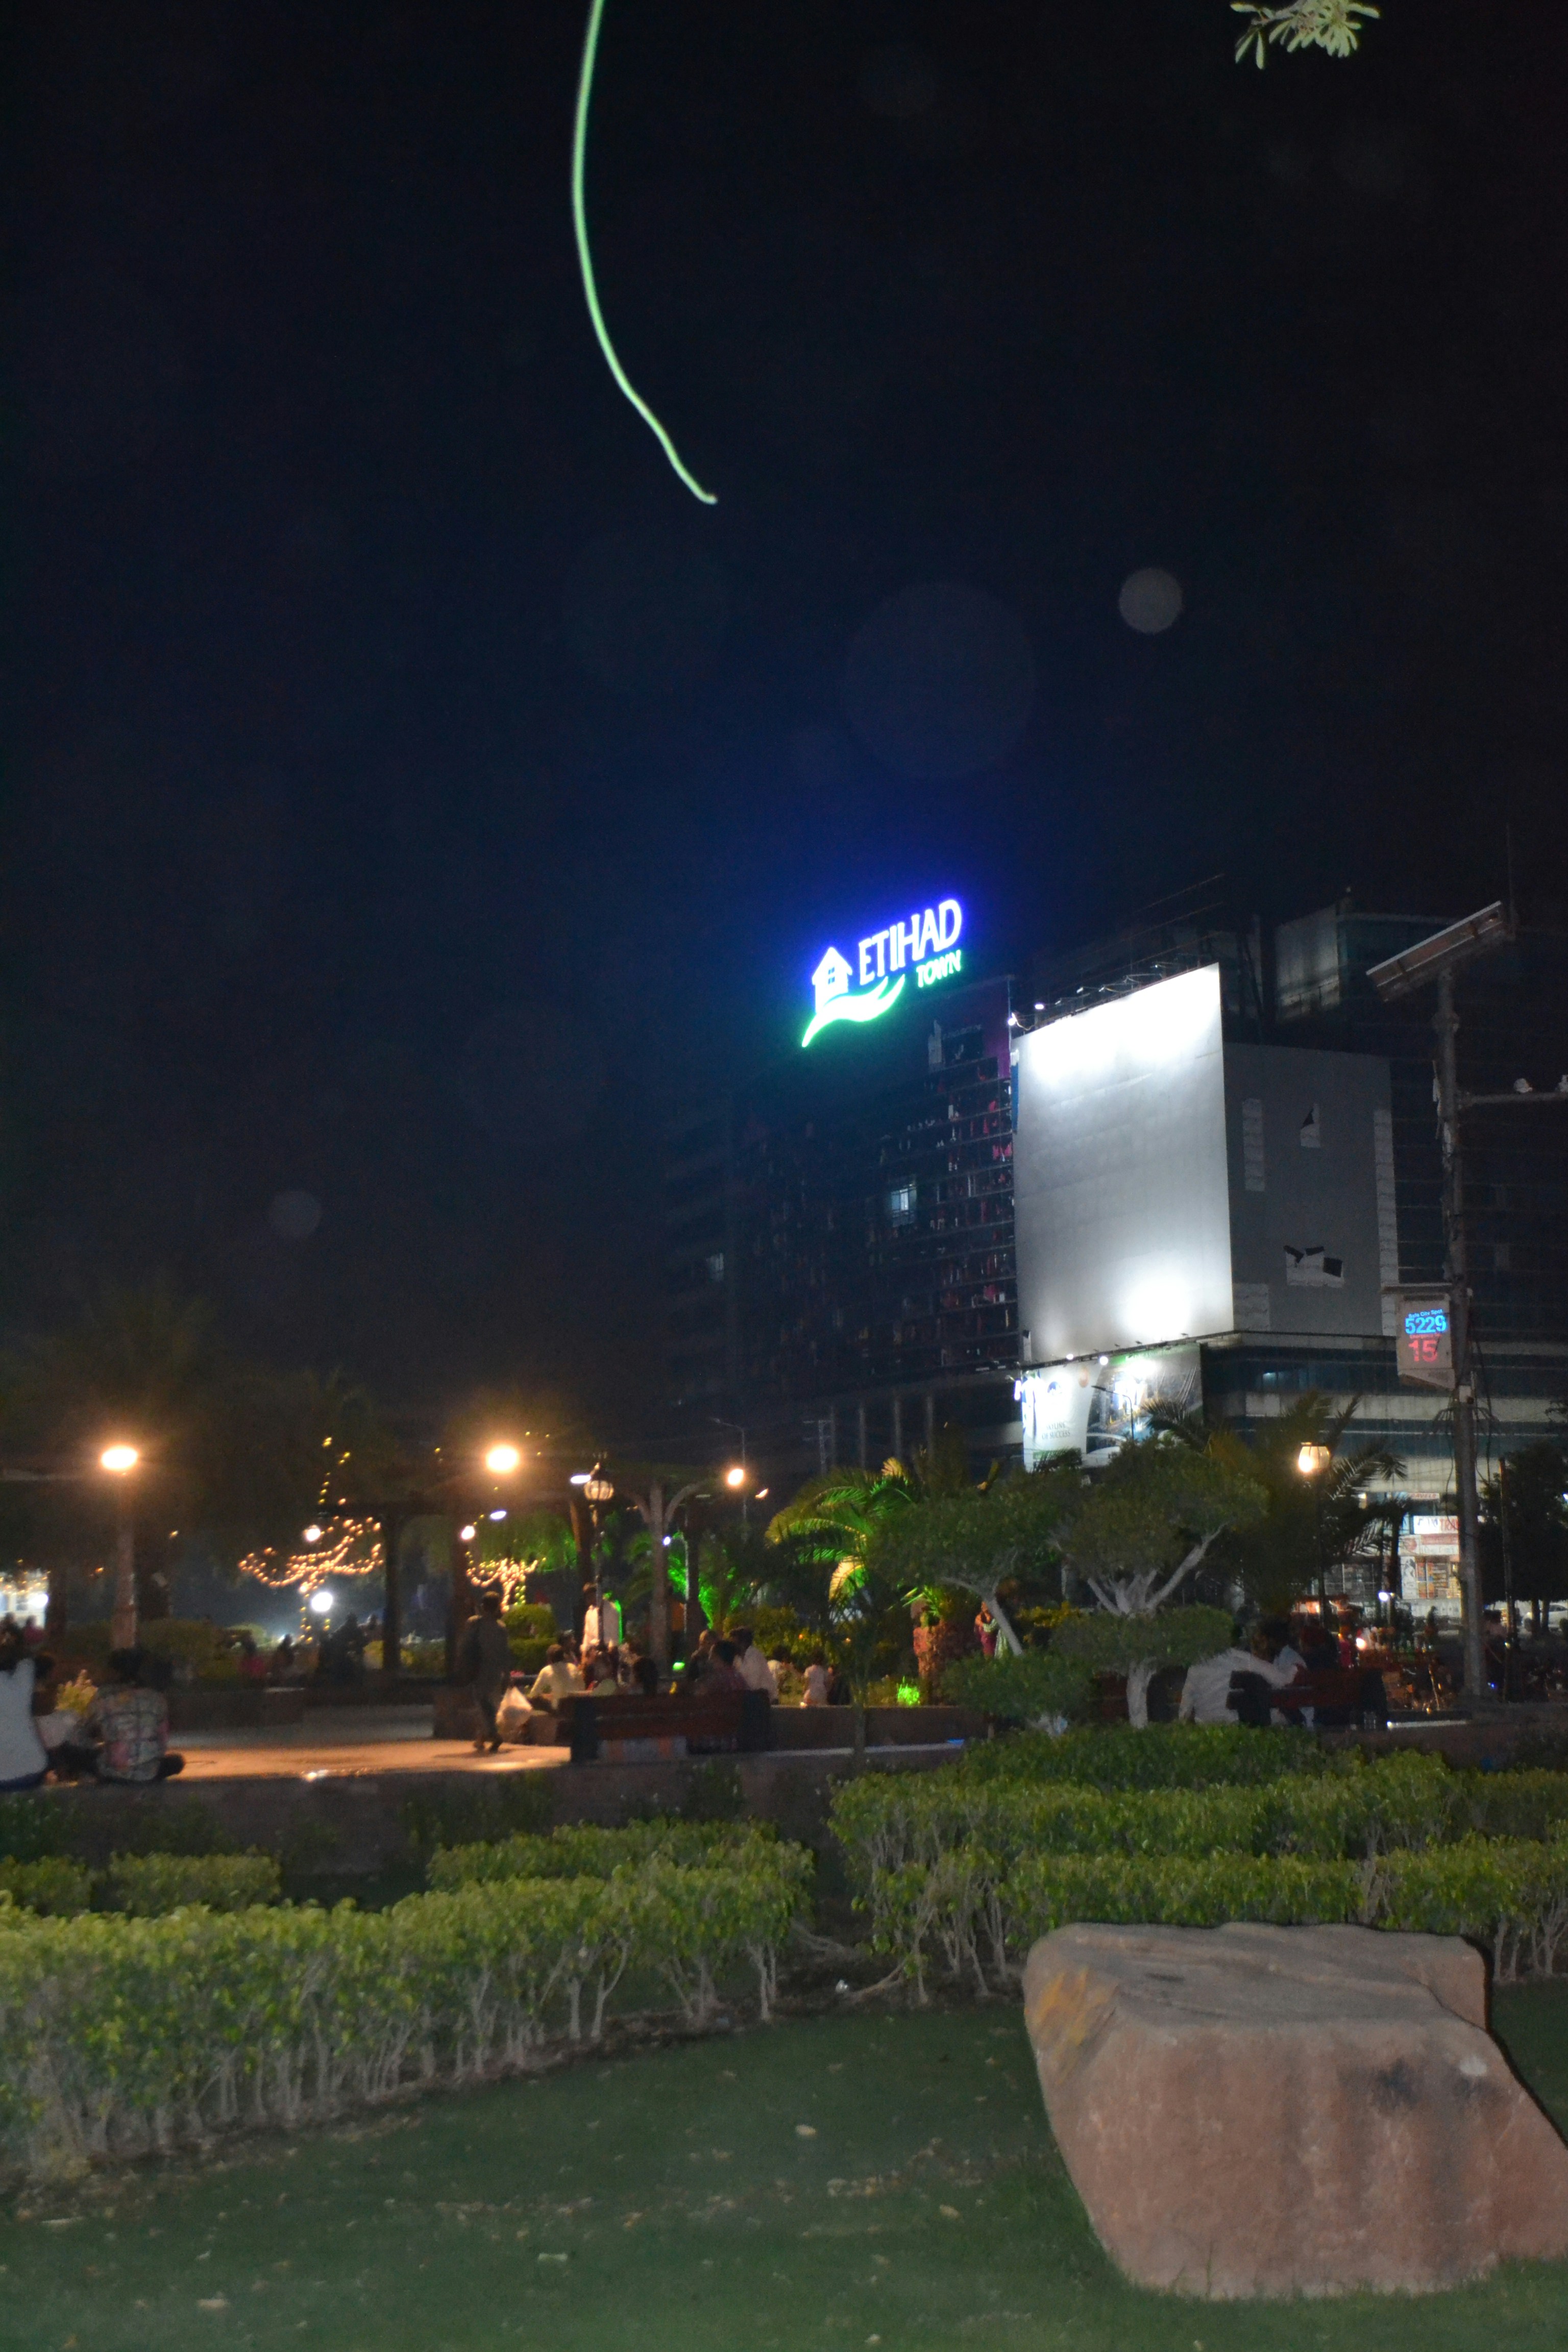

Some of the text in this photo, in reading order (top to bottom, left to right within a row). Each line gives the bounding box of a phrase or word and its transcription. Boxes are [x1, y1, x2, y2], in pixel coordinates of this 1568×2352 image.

[859, 899, 962, 986] ETIHAD
[916, 949, 961, 988] TOWN
[1405, 1315, 1447, 1334] 5229
[1408, 1340, 1438, 1362] 15
[1045, 1422, 1066, 1430] KYLINE
